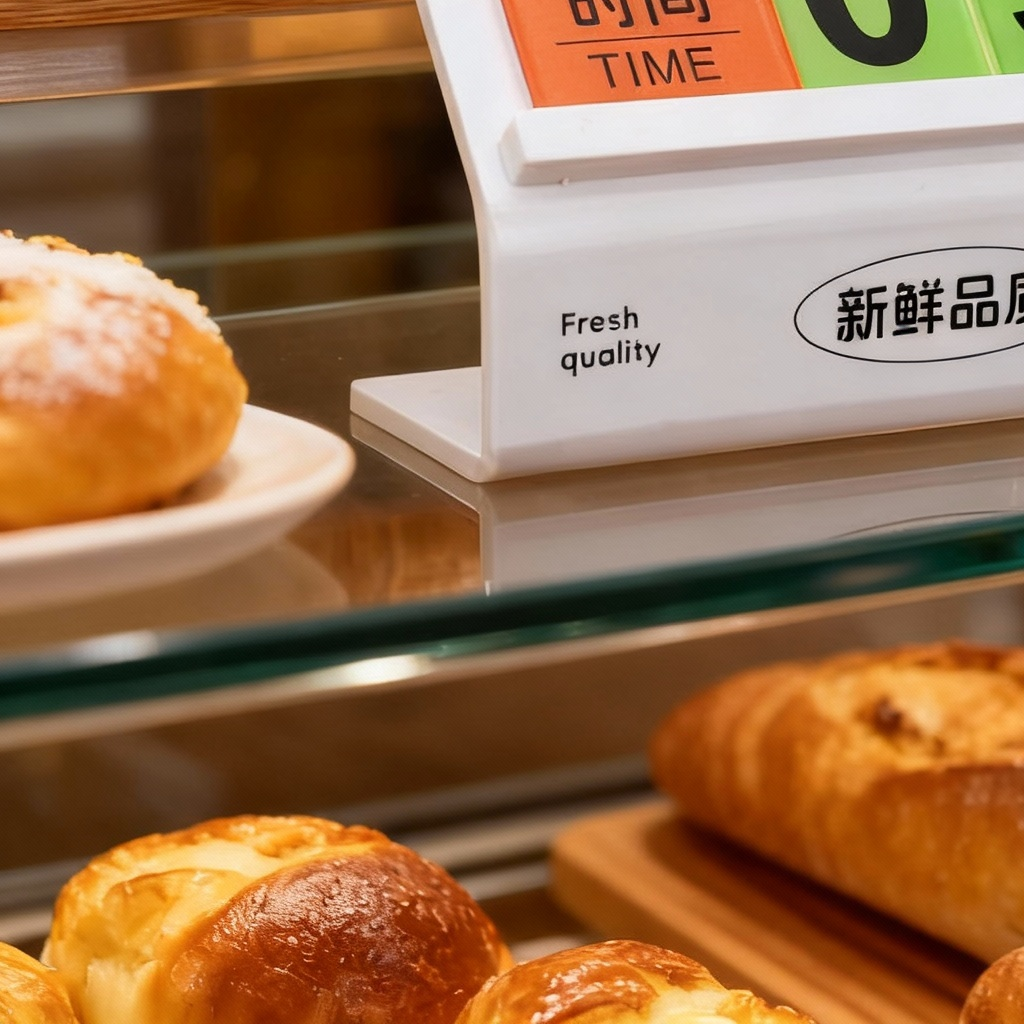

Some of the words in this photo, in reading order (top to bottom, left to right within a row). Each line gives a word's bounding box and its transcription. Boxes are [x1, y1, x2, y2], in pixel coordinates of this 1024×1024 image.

[587, 45, 723, 89] TIME
[561, 305, 640, 337] Fresh
[560, 338, 662, 377] quality
